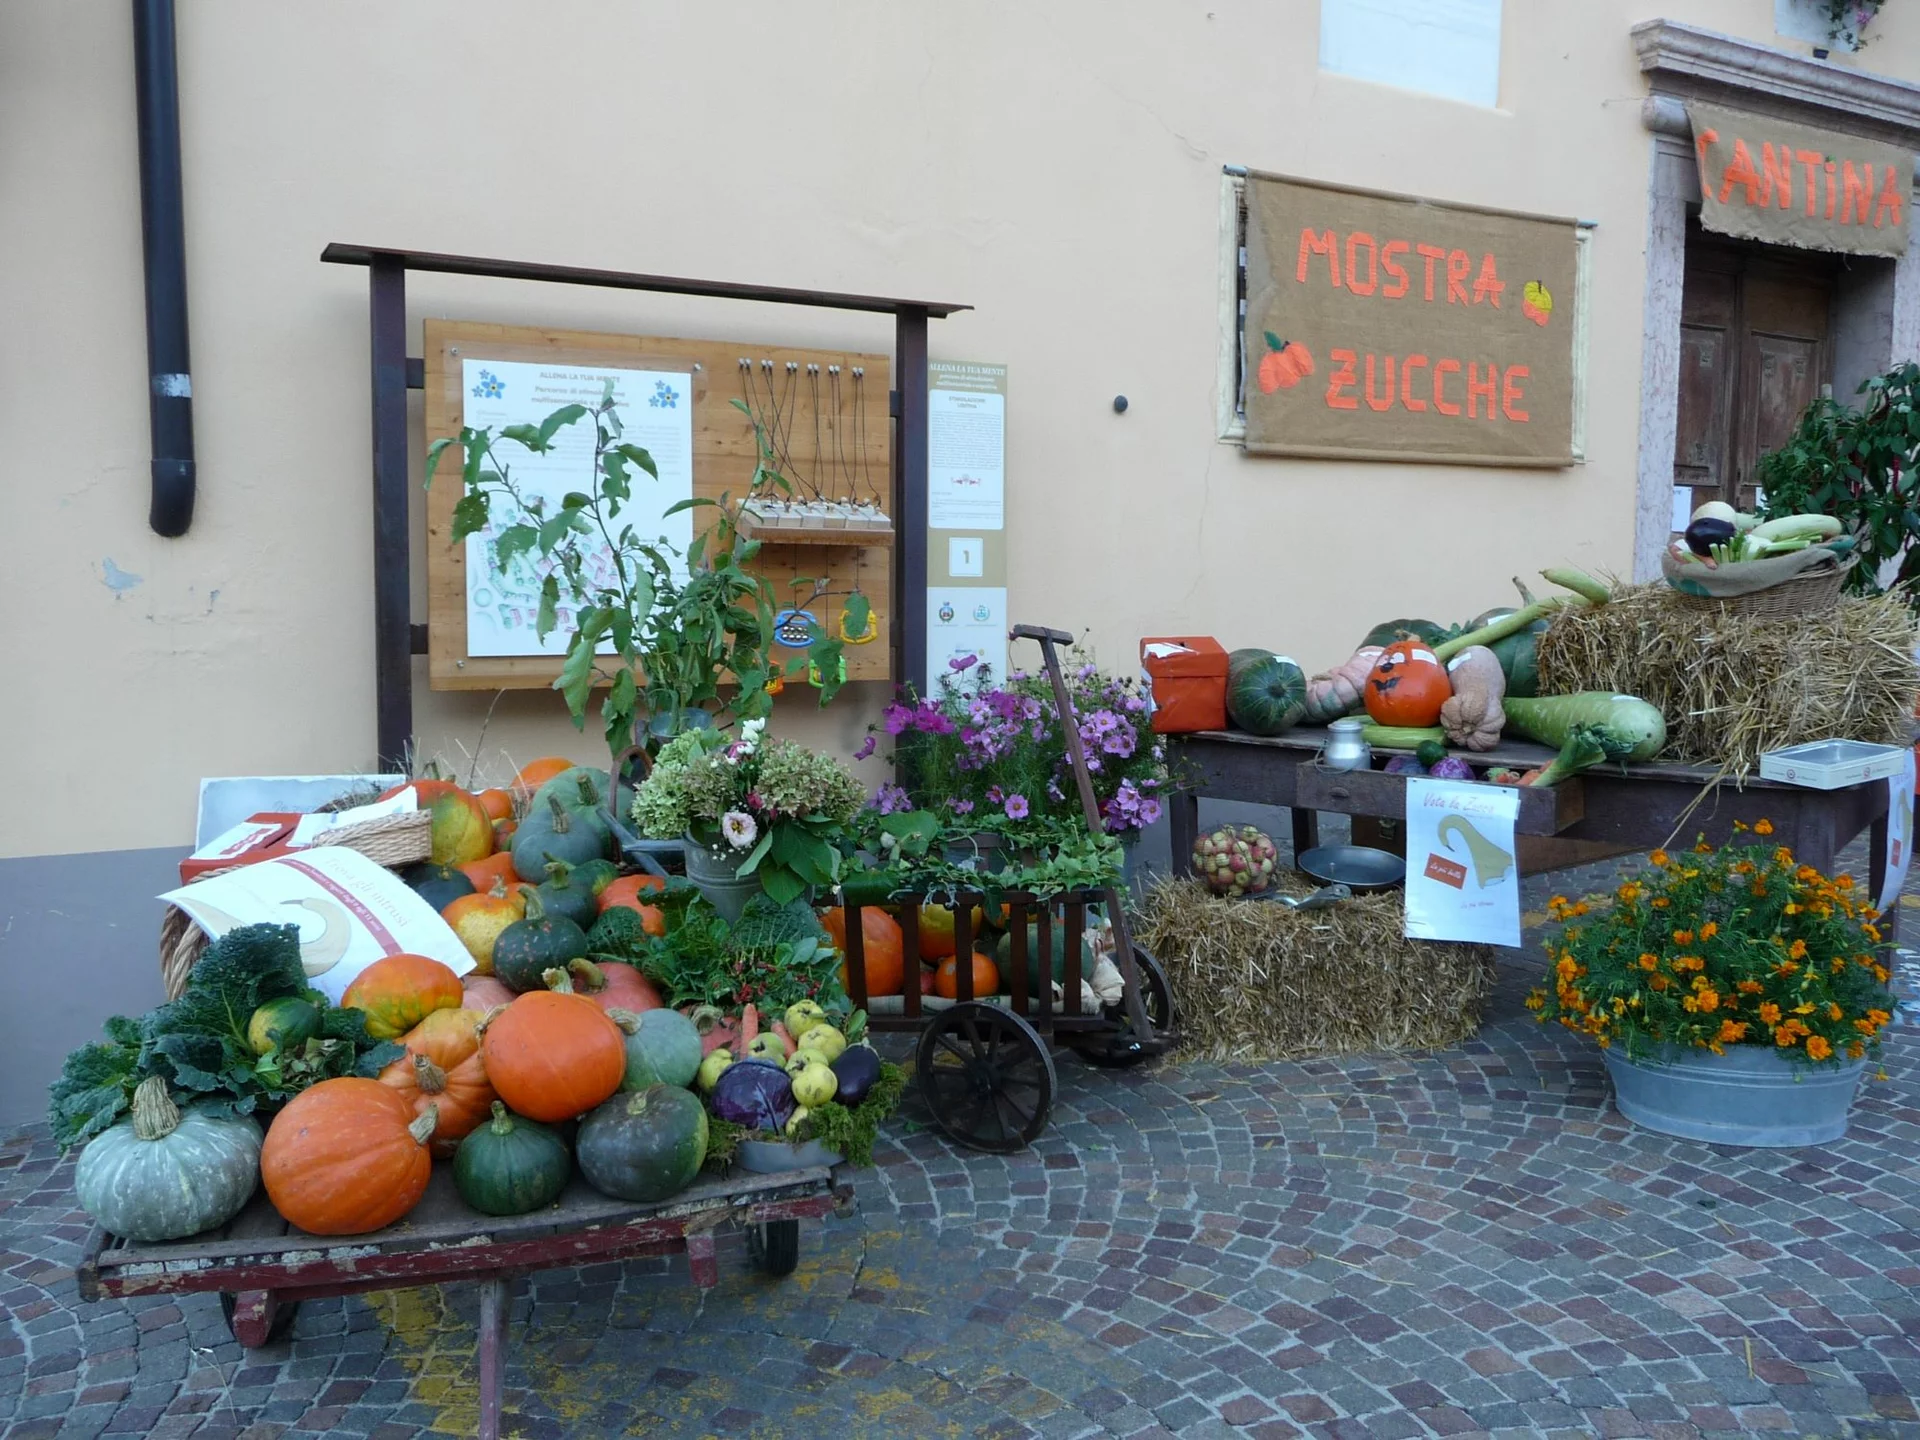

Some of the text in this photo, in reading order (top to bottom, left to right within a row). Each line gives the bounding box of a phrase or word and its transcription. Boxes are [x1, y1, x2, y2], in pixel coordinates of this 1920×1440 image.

[1296, 227, 1506, 309] MOSTRA
[540, 372, 567, 380] ALLENA
[929, 363, 955, 372] ALLENA
[981, 367, 1006, 376] MENTE
[1325, 349, 1530, 423] ZUCCHE
[962, 549, 971, 565] 1
[1423, 791, 1445, 808] Vota
